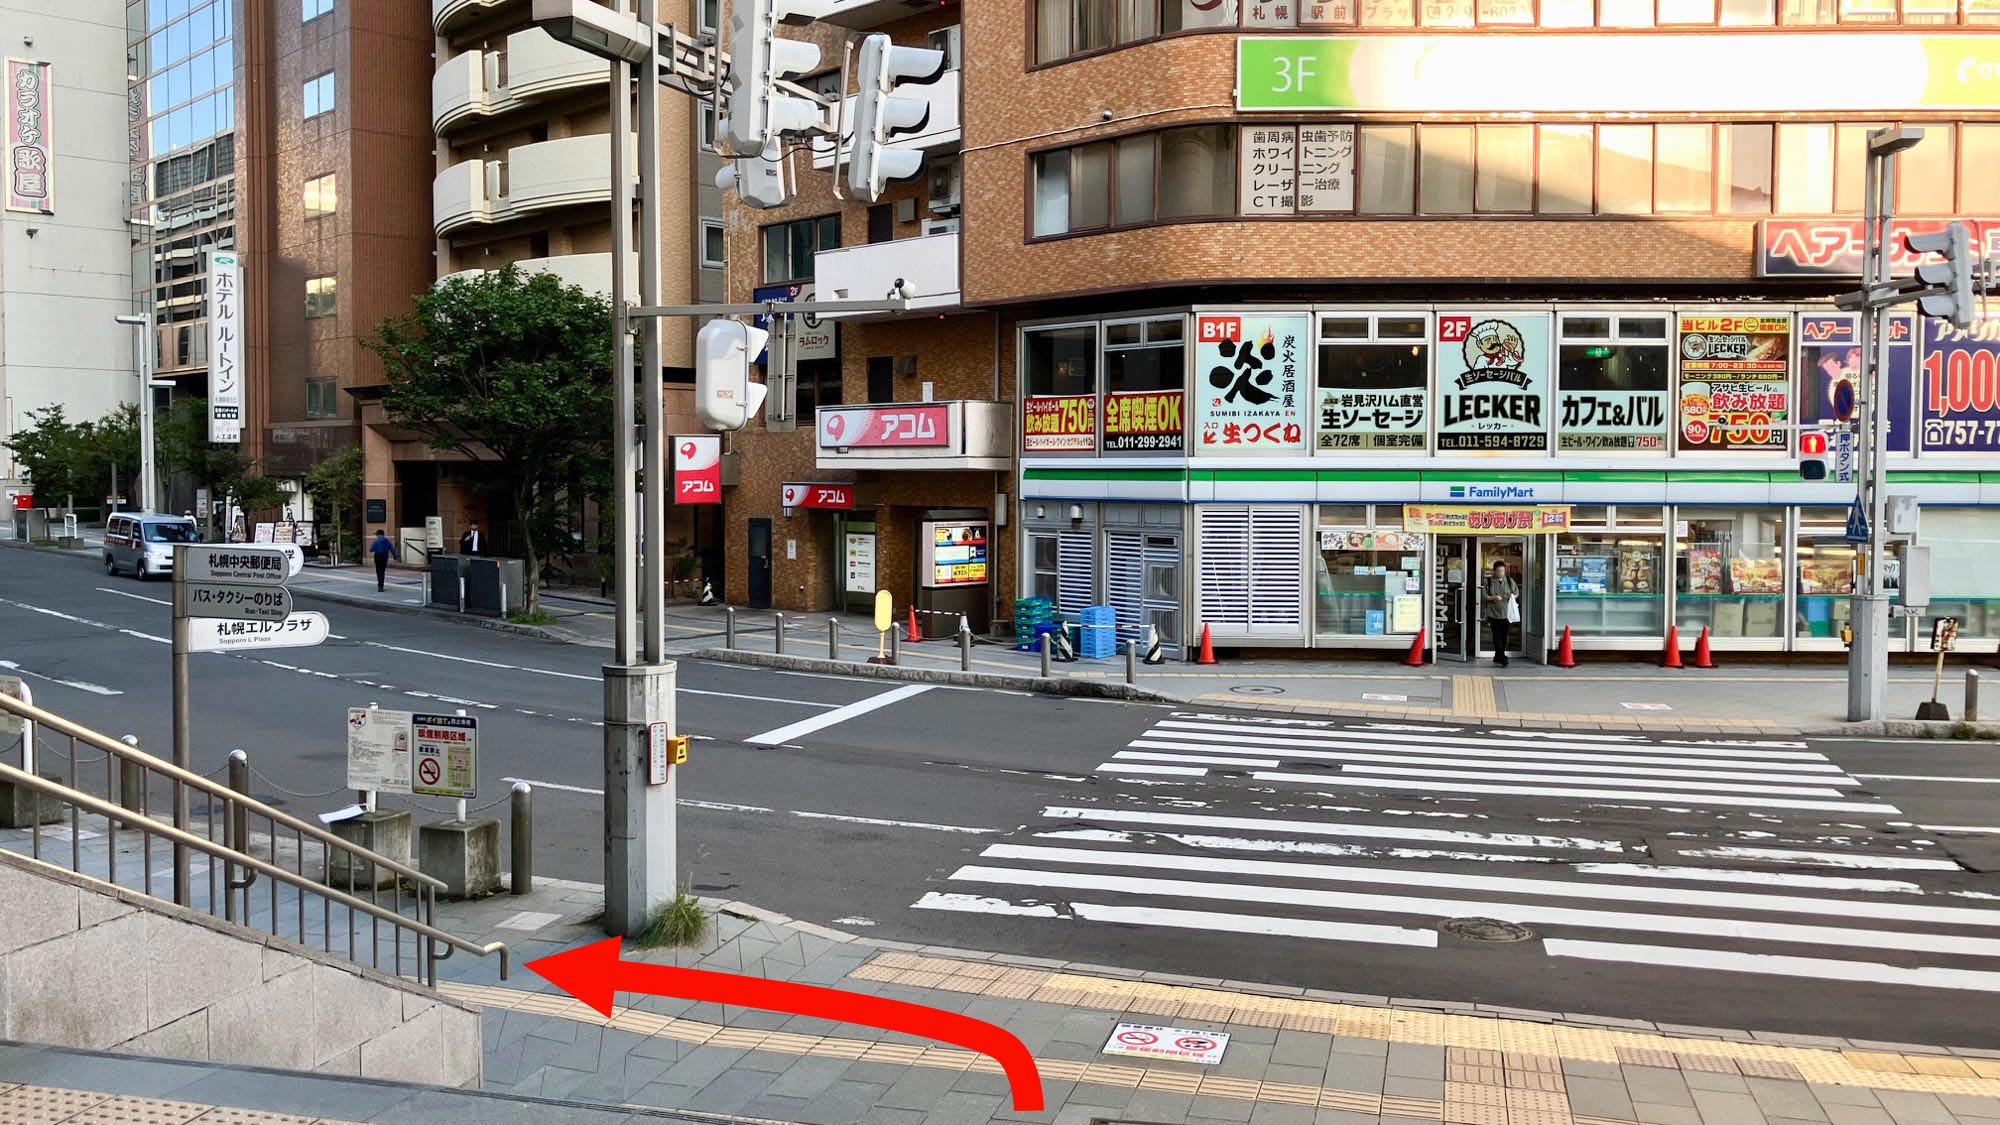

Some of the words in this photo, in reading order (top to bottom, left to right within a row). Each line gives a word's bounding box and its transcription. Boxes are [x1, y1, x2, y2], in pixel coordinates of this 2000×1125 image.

[1272, 56, 1317, 92] 3F
[1253, 131, 1294, 143] 歯周病
[1301, 130, 1352, 143] 虫歯予防
[1203, 321, 1237, 338] B1F
[1443, 321, 1467, 338] 2F
[1708, 344, 1746, 356] LECKER
[1282, 335, 1296, 408] 炭火居酒屋
[1924, 349, 2000, 417] 1,00
[1341, 394, 1424, 407] 岩見沢ハム直営
[1712, 393, 1785, 410] 飲み放題
[1106, 396, 1182, 433] 全席喫煙OK
[1321, 409, 1424, 429] 生ソーセージ
[1444, 395, 1541, 428] LECKER
[880, 412, 936, 440] アコム
[1222, 422, 1301, 444] 生つくね
[1478, 422, 1508, 430] レッカー
[1944, 420, 2000, 445] 757-7
[1321, 434, 1360, 447] 全72席
[1373, 434, 1424, 447] 個室完備
[681, 480, 714, 493] アコム
[1469, 486, 1534, 499] FamilyMart
[817, 489, 845, 504] アコム
[208, 553, 282, 571] 札幌中央郵便局
[1436, 545, 1449, 648] FamilyMart
